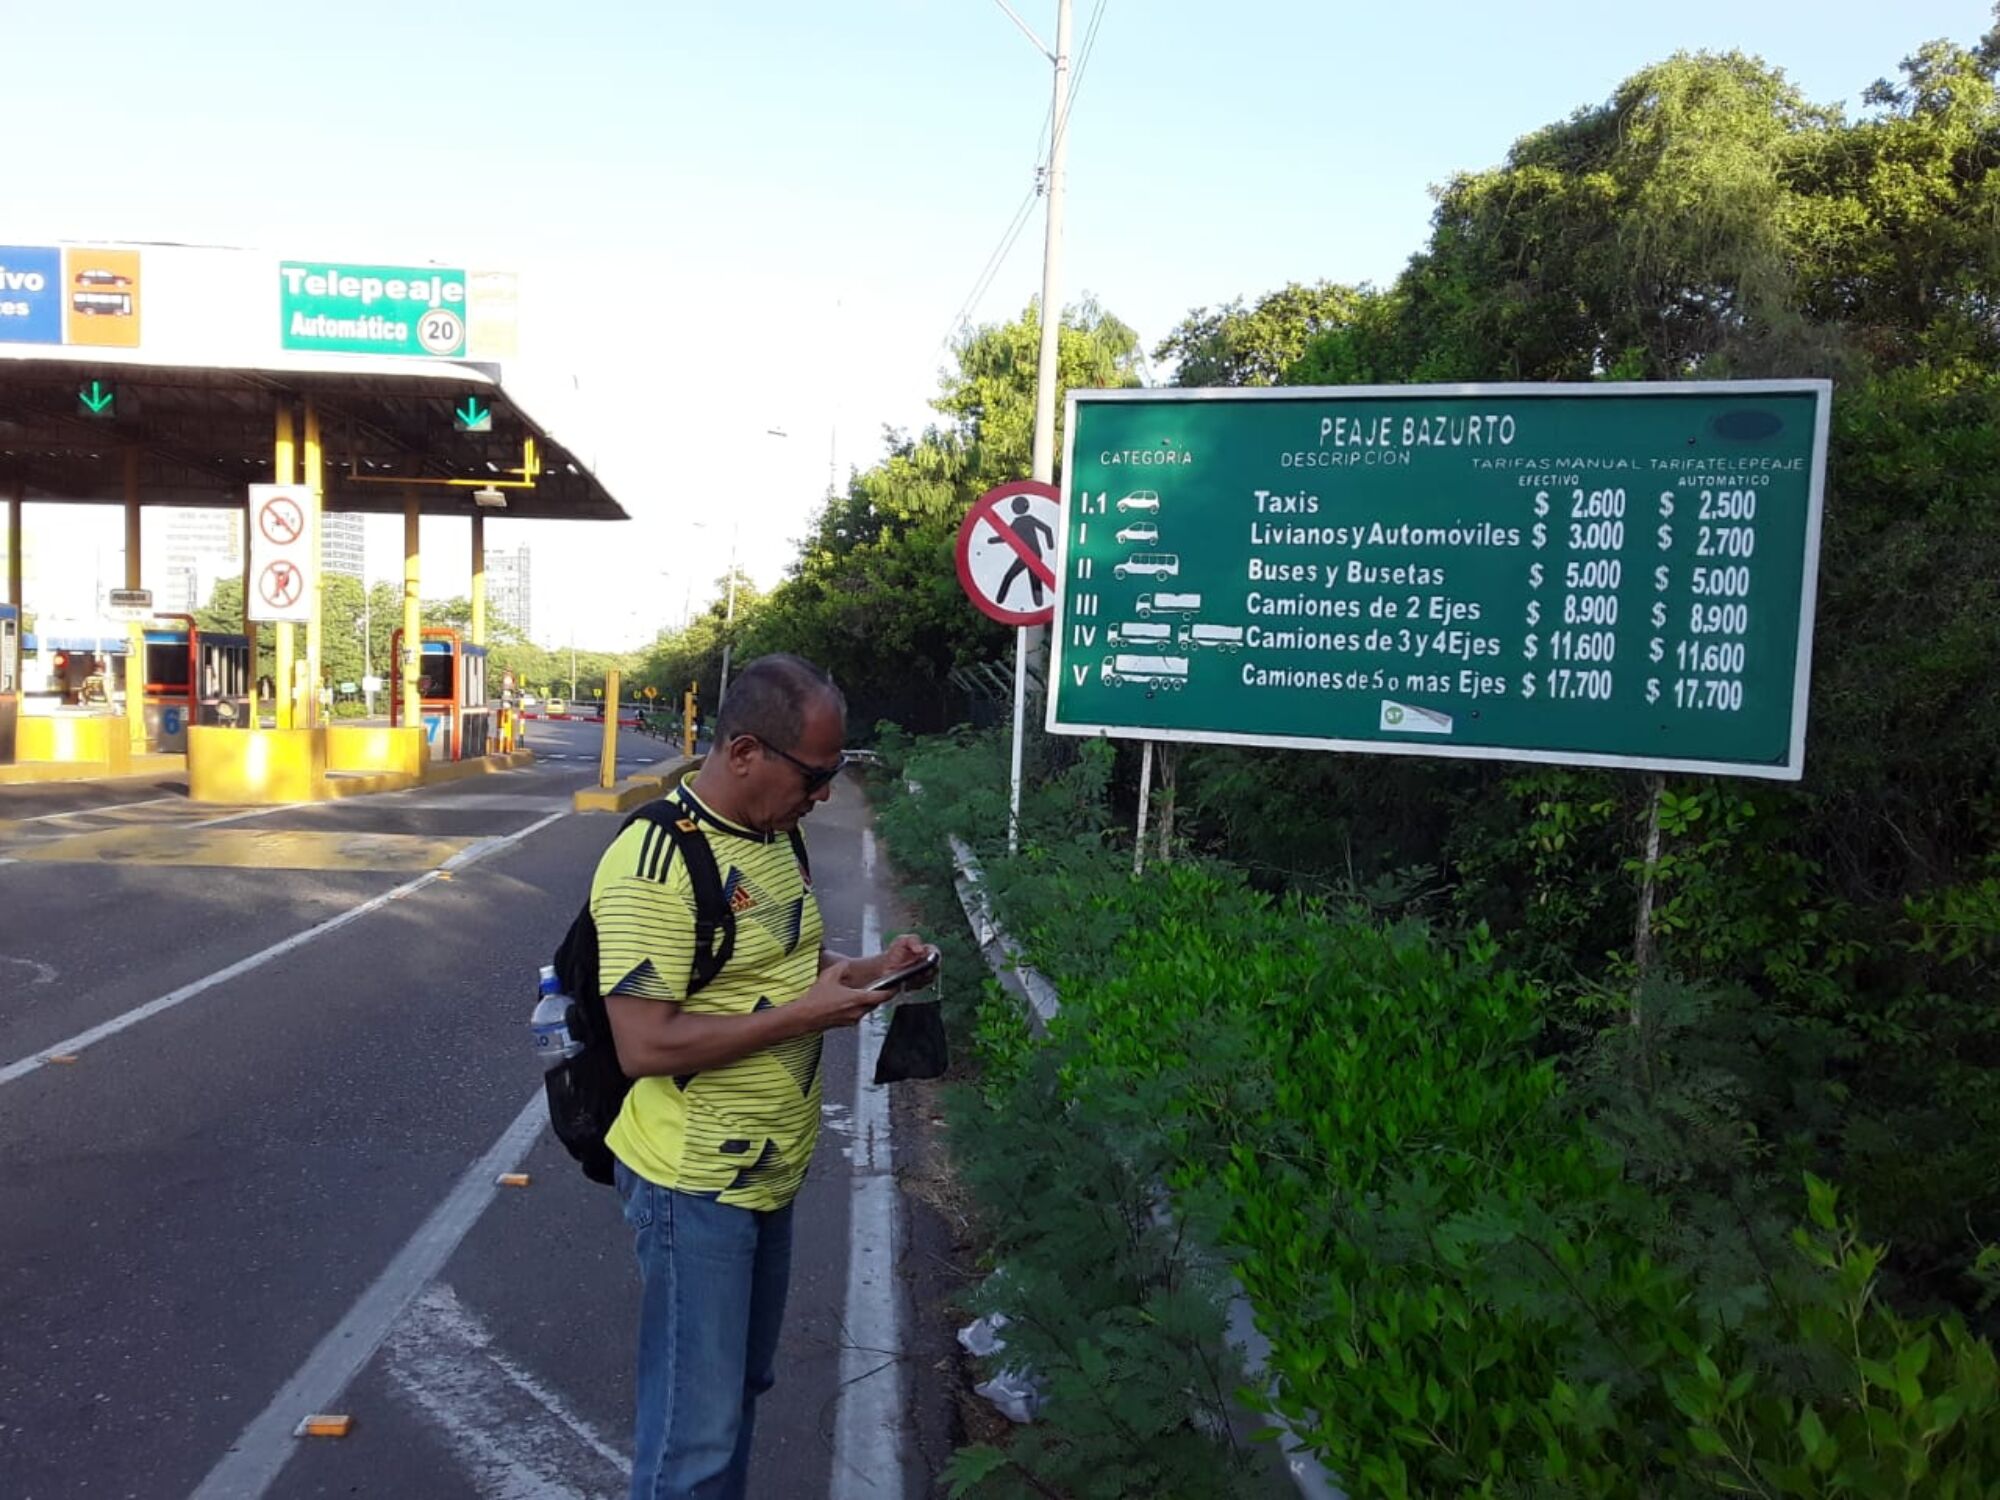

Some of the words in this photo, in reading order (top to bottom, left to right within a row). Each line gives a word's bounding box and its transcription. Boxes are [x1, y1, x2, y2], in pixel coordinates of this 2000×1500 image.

[281, 268, 465, 308] Telepeaje
[290, 310, 408, 342] Automático
[427, 320, 455, 341] 20
[1319, 417, 1393, 447] PEAJE
[1402, 414, 1516, 446] BAZURTO
[1555, 457, 1641, 470] MANUAL
[1518, 474, 1579, 487] EFECTIVO
[1677, 475, 1770, 487] AUTOMATICO
[1253, 490, 1319, 514] Taxis
[1533, 490, 1550, 518] $
[1571, 488, 1626, 519] 2.600
[1658, 490, 1674, 518] $
[1698, 489, 1756, 521] 2.500
[1531, 522, 1547, 550] $
[1568, 520, 1625, 551] 3.000
[1657, 523, 1673, 551] $
[1696, 525, 1755, 558] 2.700
[1077, 557, 1092, 580] II
[1248, 557, 1318, 582] Buses
[1325, 565, 1339, 589] y
[1346, 560, 1444, 586] Busetas
[1528, 562, 1544, 590] $
[1565, 559, 1622, 590] 5.000
[1654, 564, 1670, 593] $
[1691, 565, 1750, 598] 5.000
[1075, 593, 1098, 617] III
[1246, 591, 1361, 618] Camiones
[1369, 595, 1398, 619] de
[1406, 595, 1421, 619] 2
[1429, 596, 1481, 627] Ejes
[1526, 599, 1541, 627] $
[1564, 594, 1618, 626] 8.900
[1651, 601, 1667, 629] $
[1690, 602, 1748, 635] 8.900
[1073, 624, 1097, 647] IV
[1246, 625, 1360, 651] Camiones
[1364, 628, 1393, 652] de
[1397, 628, 1411, 653] 3
[1414, 634, 1429, 658] y
[1523, 633, 1539, 661] $
[1550, 630, 1615, 662] 11.600
[1649, 637, 1664, 664] $
[1676, 640, 1745, 674] 11.600
[1072, 663, 1090, 687] V
[1242, 663, 1343, 690] Camiones
[1388, 677, 1399, 691] o
[1407, 675, 1451, 693] mas
[1459, 669, 1506, 699] Ejes
[1521, 672, 1536, 699] $
[1547, 668, 1612, 700] 17.700
[1645, 678, 1661, 705] $
[1674, 678, 1743, 711] 17.700
[163, 707, 181, 735] 6
[423, 715, 441, 743] 7
